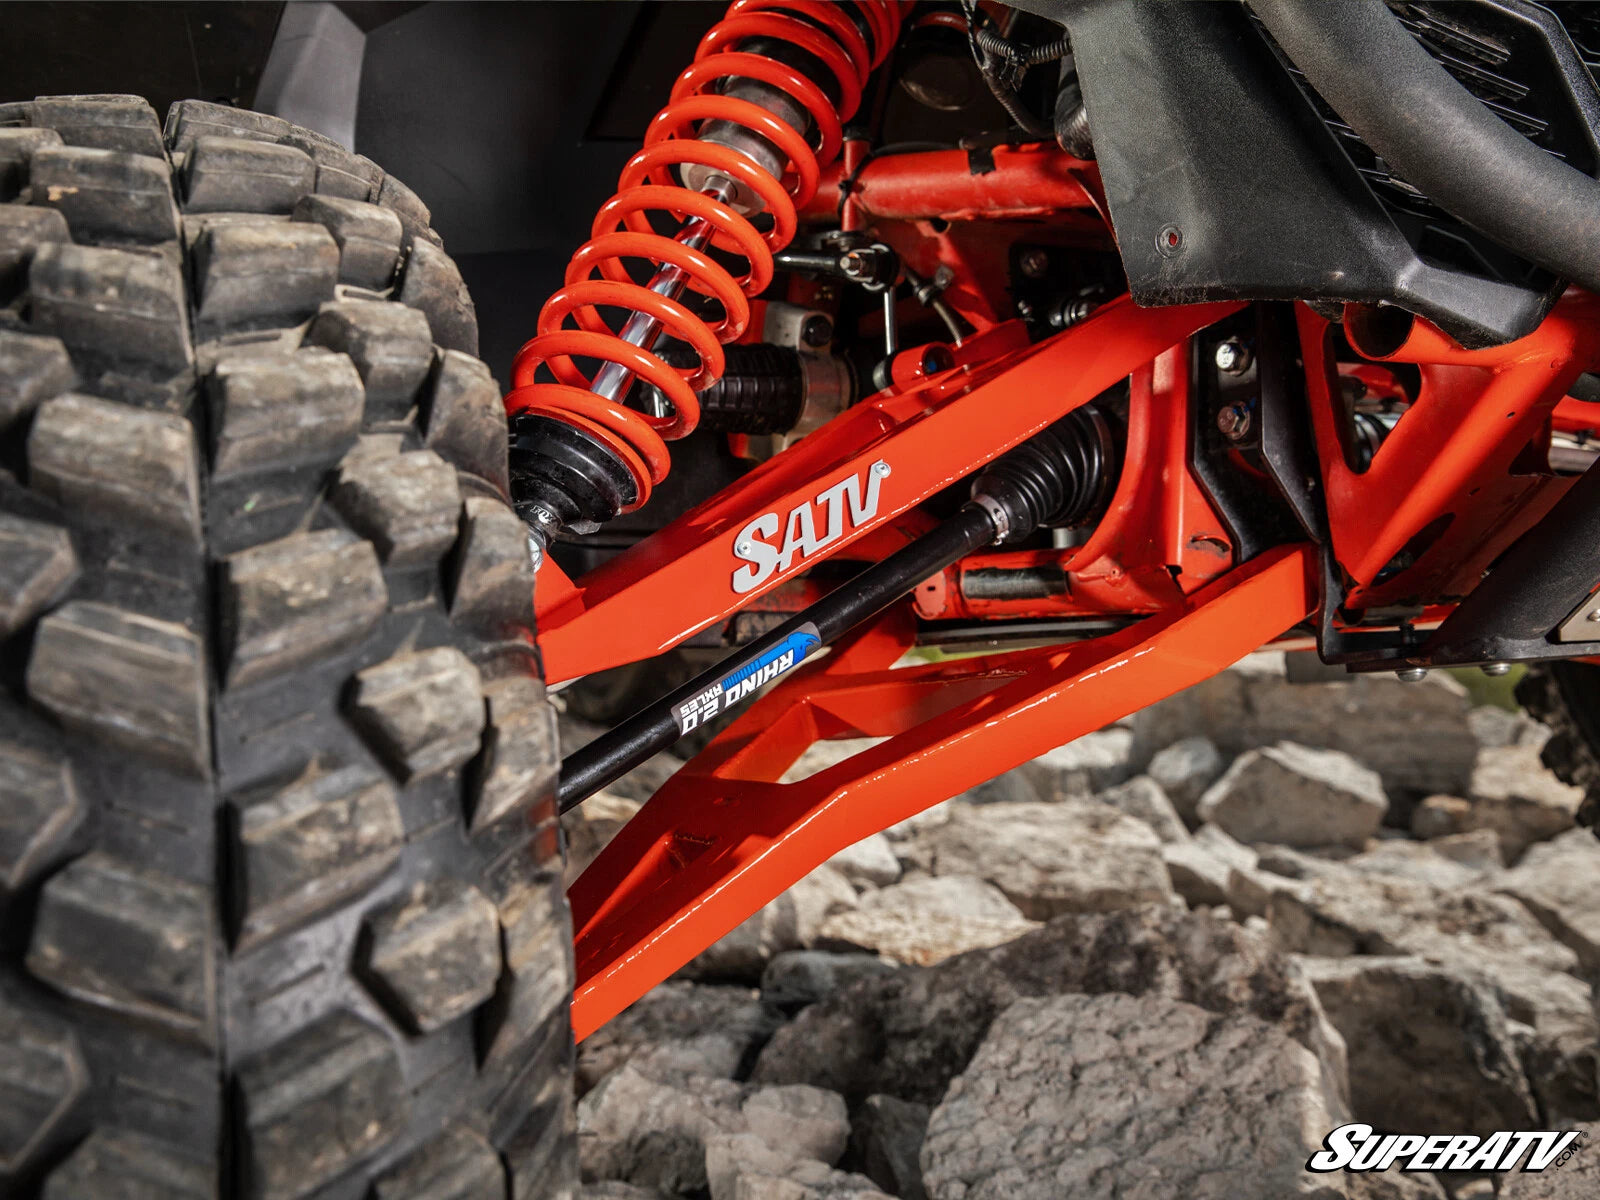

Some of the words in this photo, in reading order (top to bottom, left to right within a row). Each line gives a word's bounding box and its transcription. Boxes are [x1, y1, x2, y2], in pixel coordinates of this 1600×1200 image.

[732, 459, 886, 593] SATV
[680, 683, 724, 717] AXLES
[724, 649, 794, 708] RHINO
[682, 697, 719, 736] 2.0
